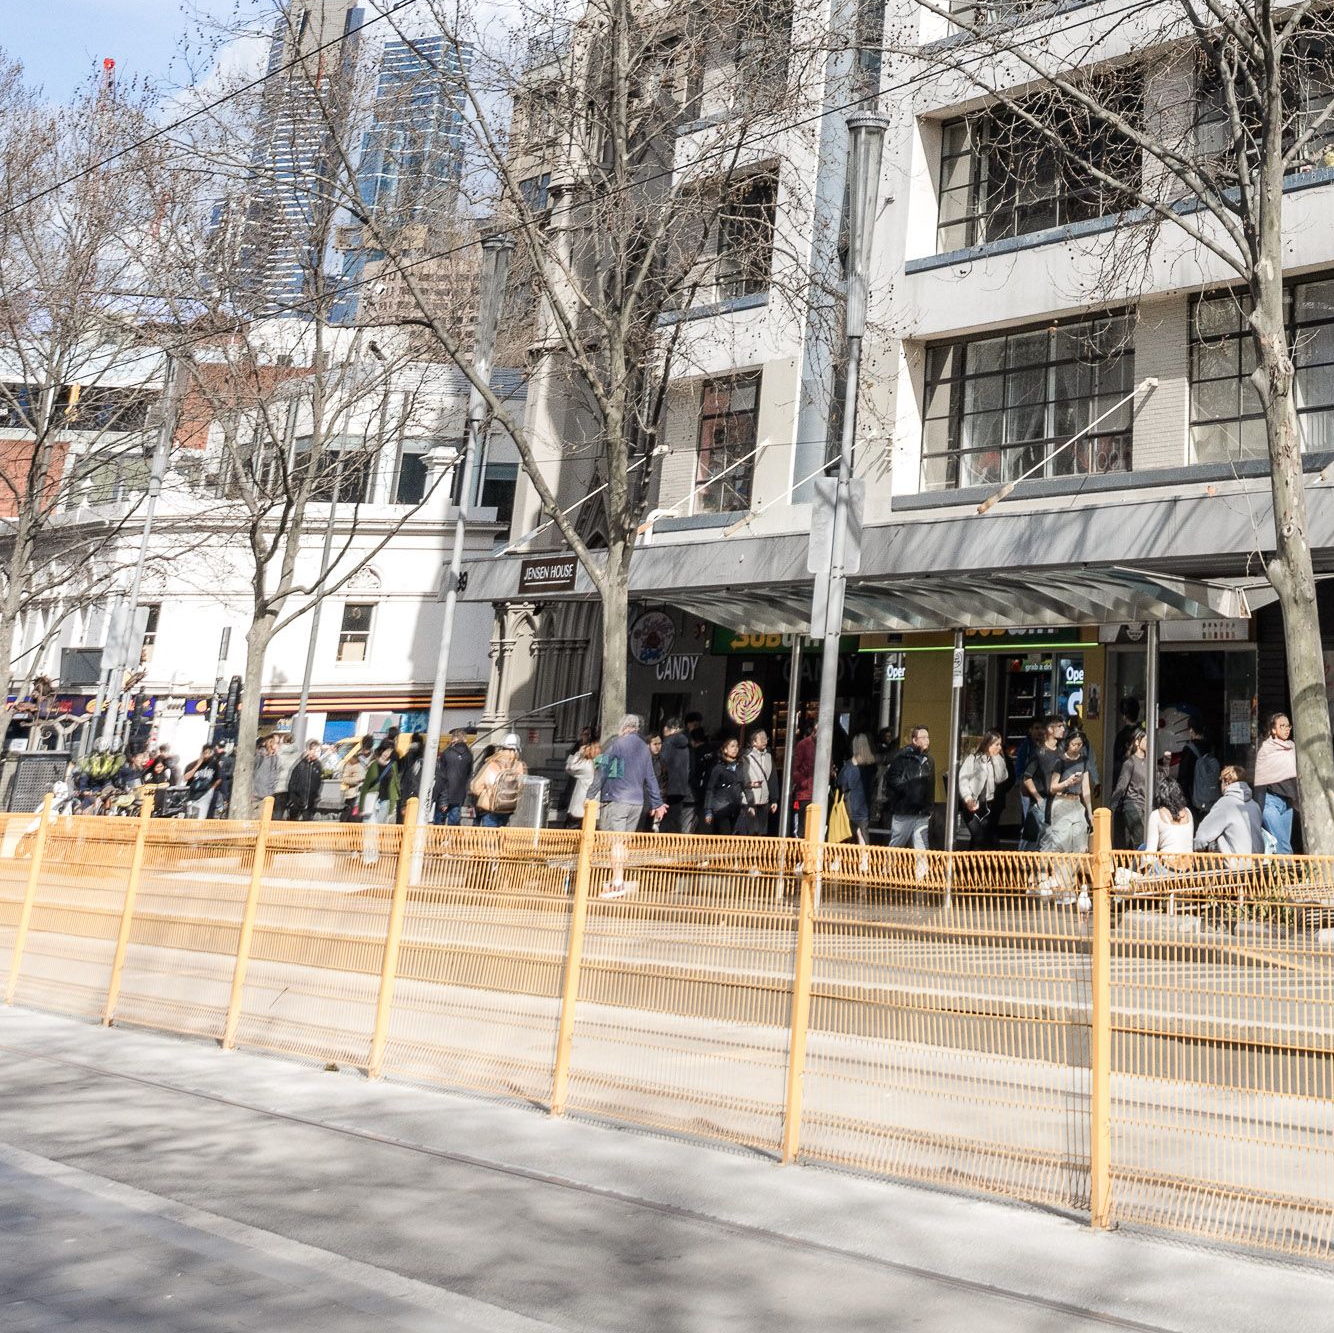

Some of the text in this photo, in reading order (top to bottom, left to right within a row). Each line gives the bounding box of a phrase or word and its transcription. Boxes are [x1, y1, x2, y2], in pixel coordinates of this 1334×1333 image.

[523, 564, 574, 580] JENSEN HOUSE
[656, 655, 699, 681] CANDY
[1025, 663, 1039, 673] grab
